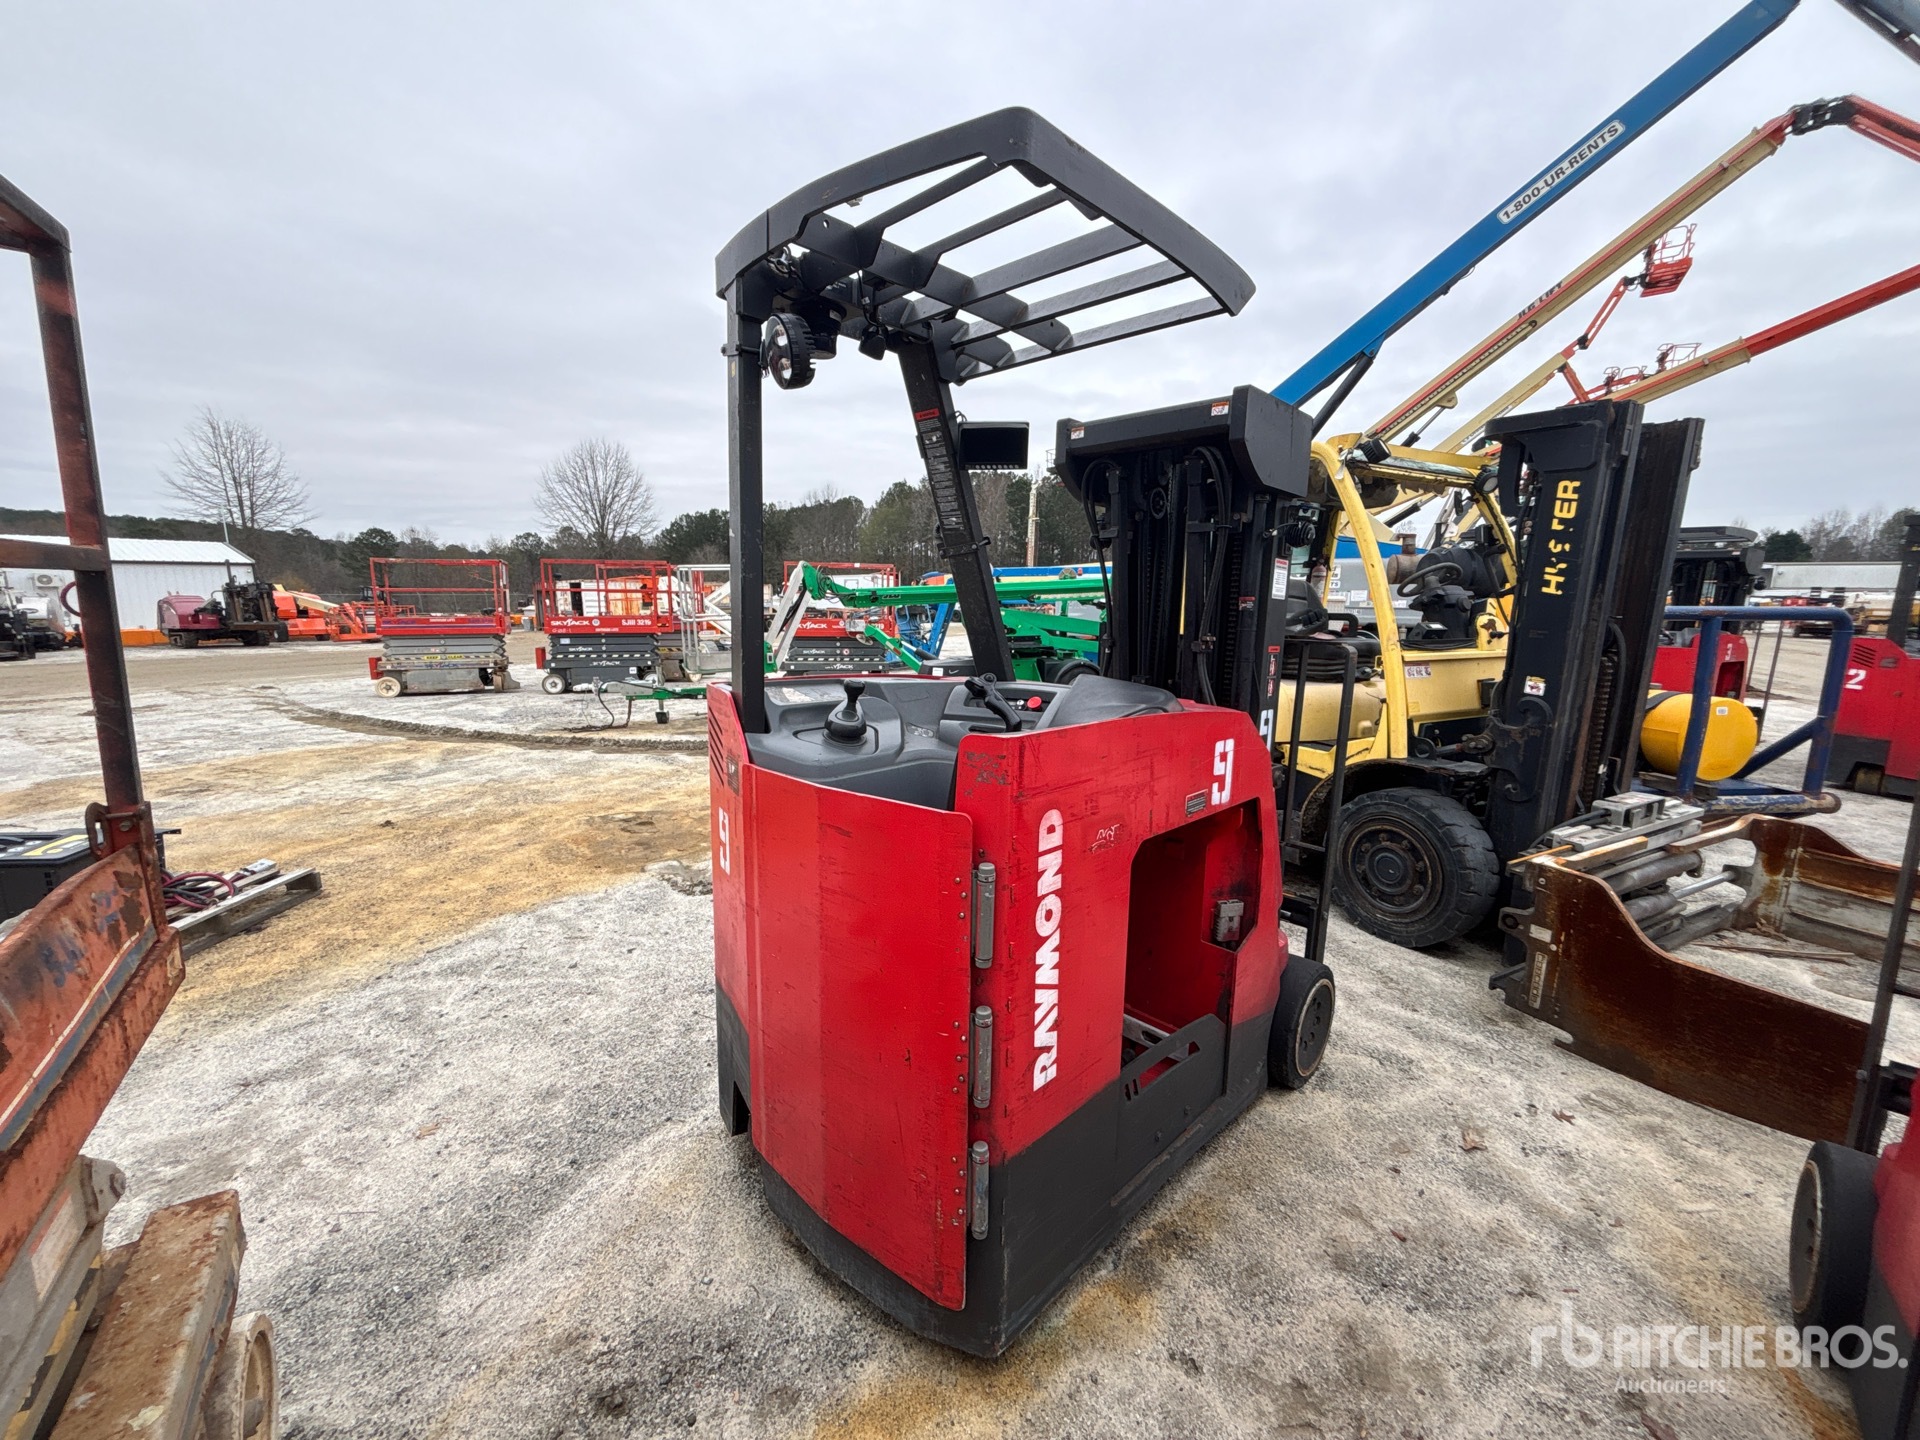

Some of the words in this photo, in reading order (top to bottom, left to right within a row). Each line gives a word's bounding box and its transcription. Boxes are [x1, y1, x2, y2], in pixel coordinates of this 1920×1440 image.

[1502, 124, 1619, 220] 1-800-UR-RENTS
[551, 618, 590, 627] SKYJACK
[1725, 643, 1733, 661] 3
[1844, 668, 1867, 690] 2
[1211, 738, 1235, 806] 9
[718, 806, 731, 876] 9
[1033, 808, 1064, 1092] RAYMOND
